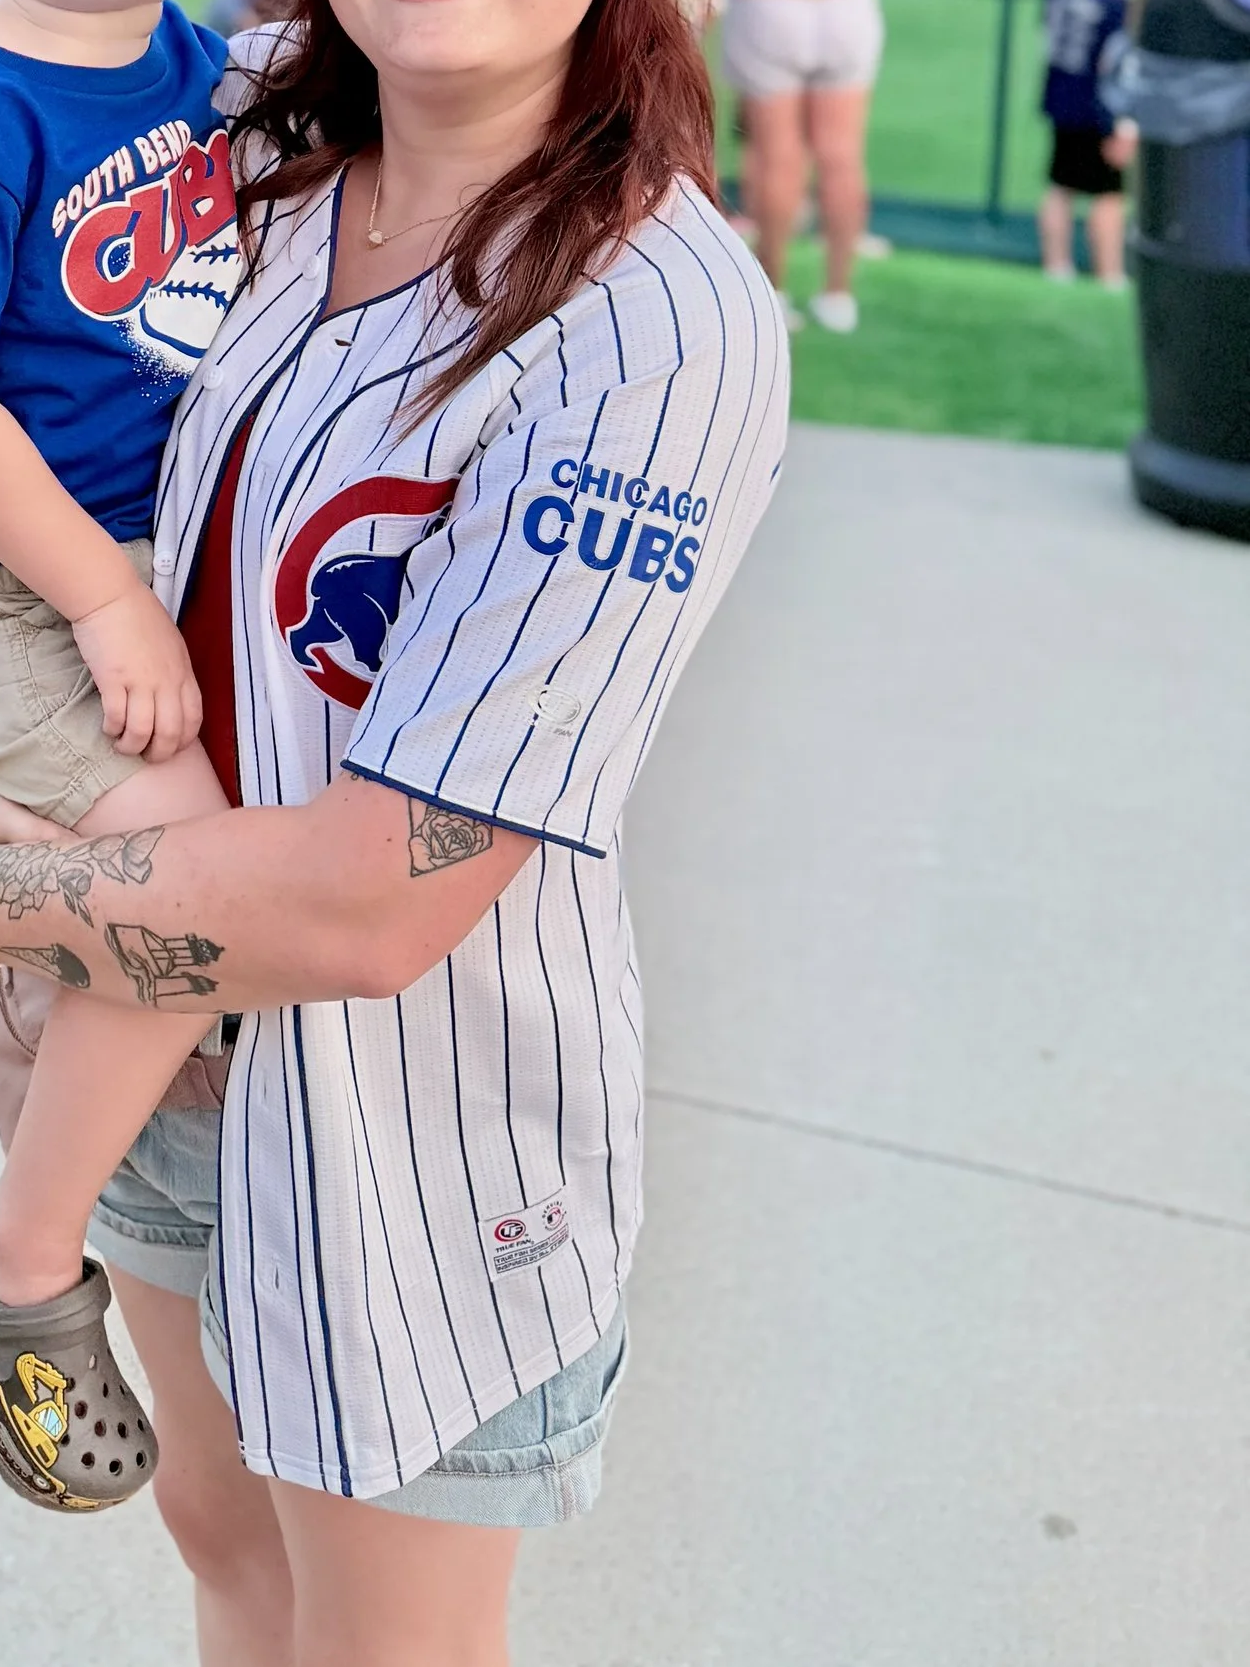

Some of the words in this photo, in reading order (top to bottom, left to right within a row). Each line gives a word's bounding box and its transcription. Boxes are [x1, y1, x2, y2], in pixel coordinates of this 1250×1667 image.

[52, 145, 136, 238] SOUTH
[133, 120, 192, 175] BEND
[62, 130, 238, 320] CUB
[551, 458, 708, 527] CHICAGO
[523, 495, 700, 594] CUBS
[495, 1243, 515, 1253] TRUE
[496, 1254, 514, 1264] TRUE
[497, 1257, 528, 1271] INSPIRED
